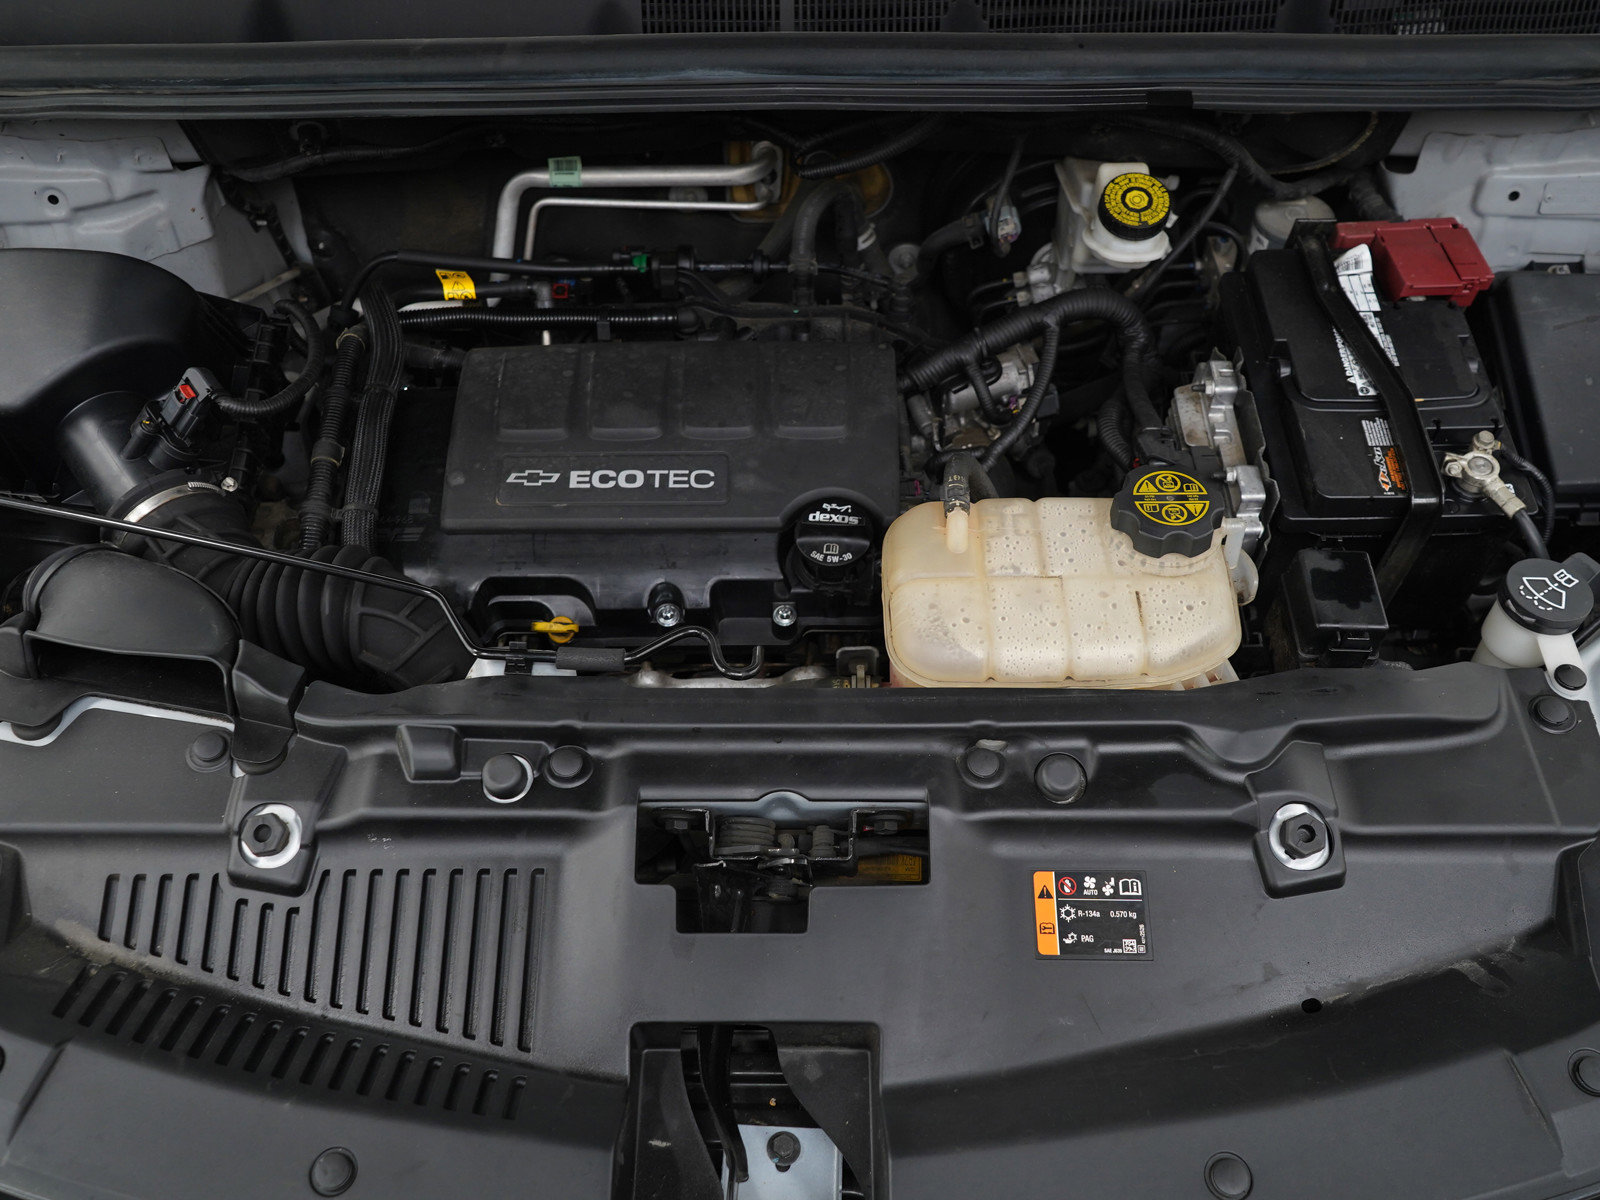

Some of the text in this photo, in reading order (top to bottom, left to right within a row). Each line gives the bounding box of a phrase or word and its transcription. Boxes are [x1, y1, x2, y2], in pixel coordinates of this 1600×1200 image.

[569, 469, 715, 489] ECOTEC
[808, 511, 859, 525] dexos
[810, 550, 853, 563] SAE 5W-30
[1078, 910, 1137, 919] R-134a 0.570 kg
[1081, 935, 1094, 943] PAG
